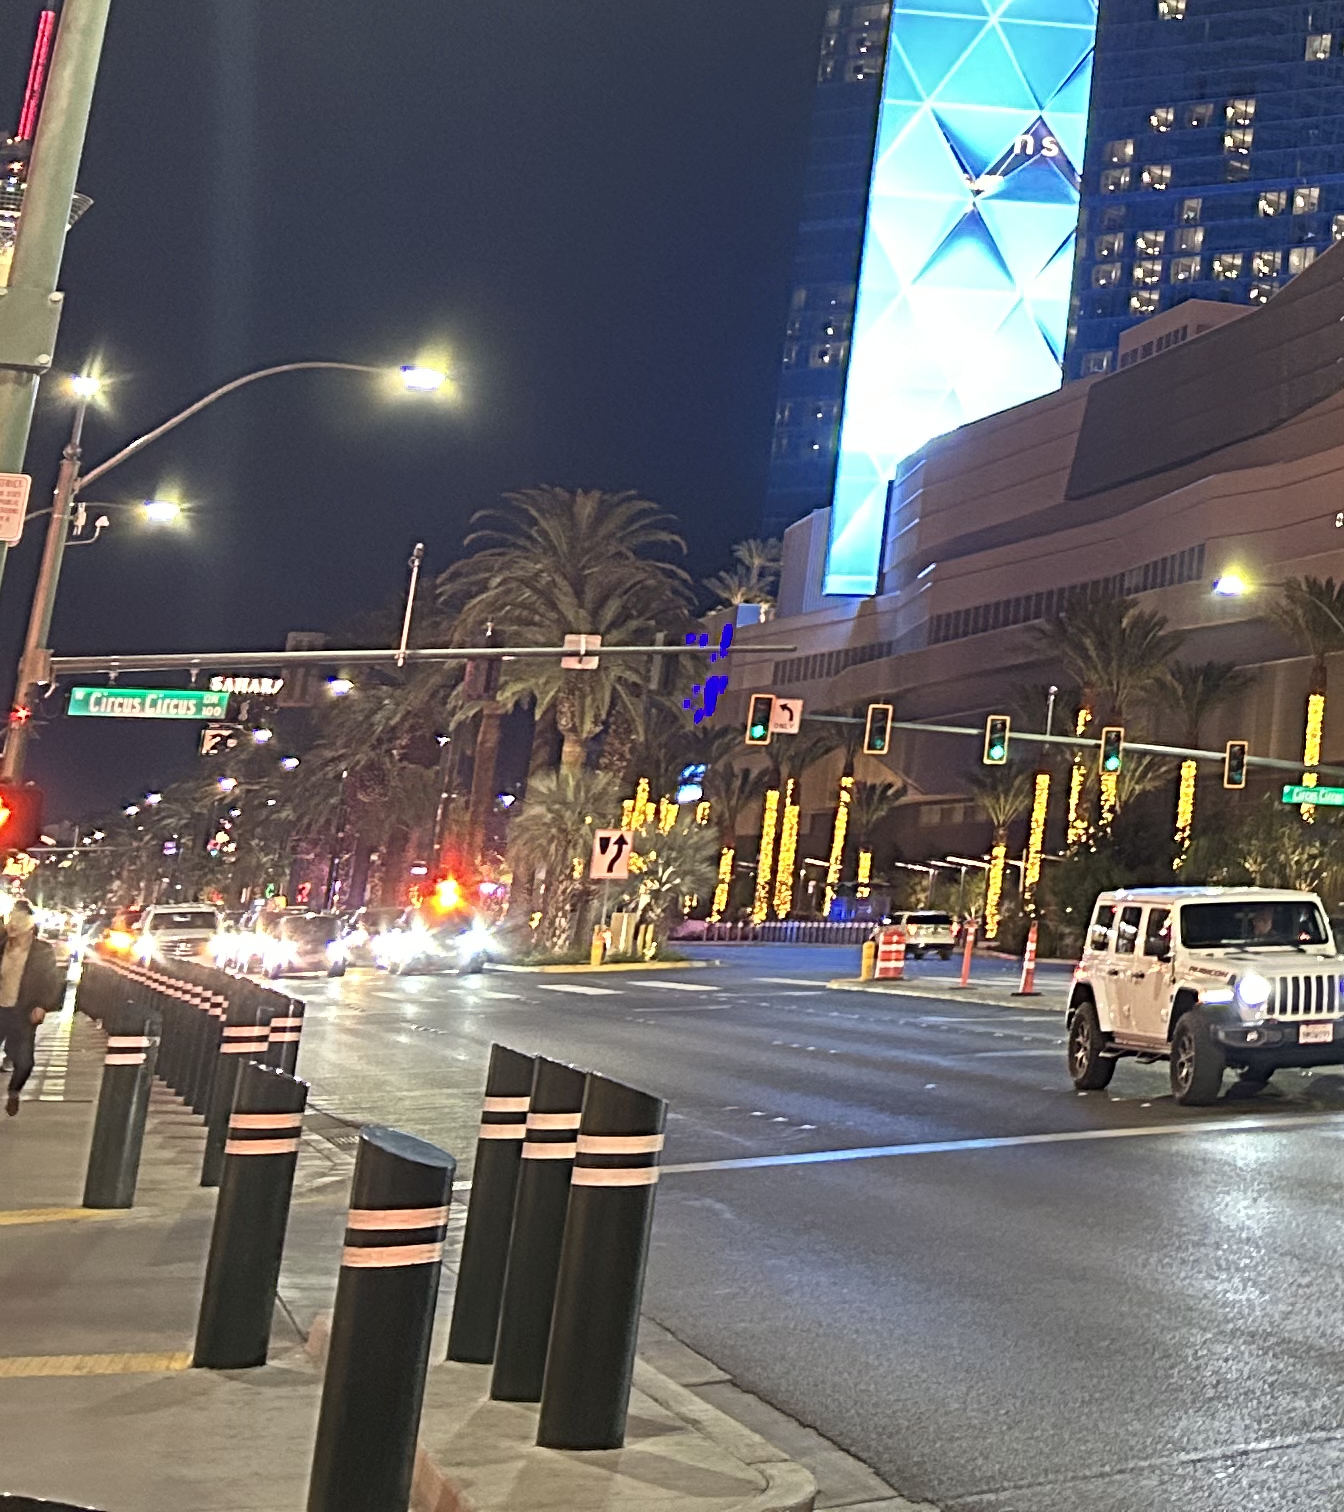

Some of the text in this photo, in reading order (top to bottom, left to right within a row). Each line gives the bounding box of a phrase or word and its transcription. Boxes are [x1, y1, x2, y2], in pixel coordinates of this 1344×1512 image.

[89, 692, 141, 713] Circus
[145, 693, 196, 715] Circus
[1189, 966, 1229, 978] RUBICON
